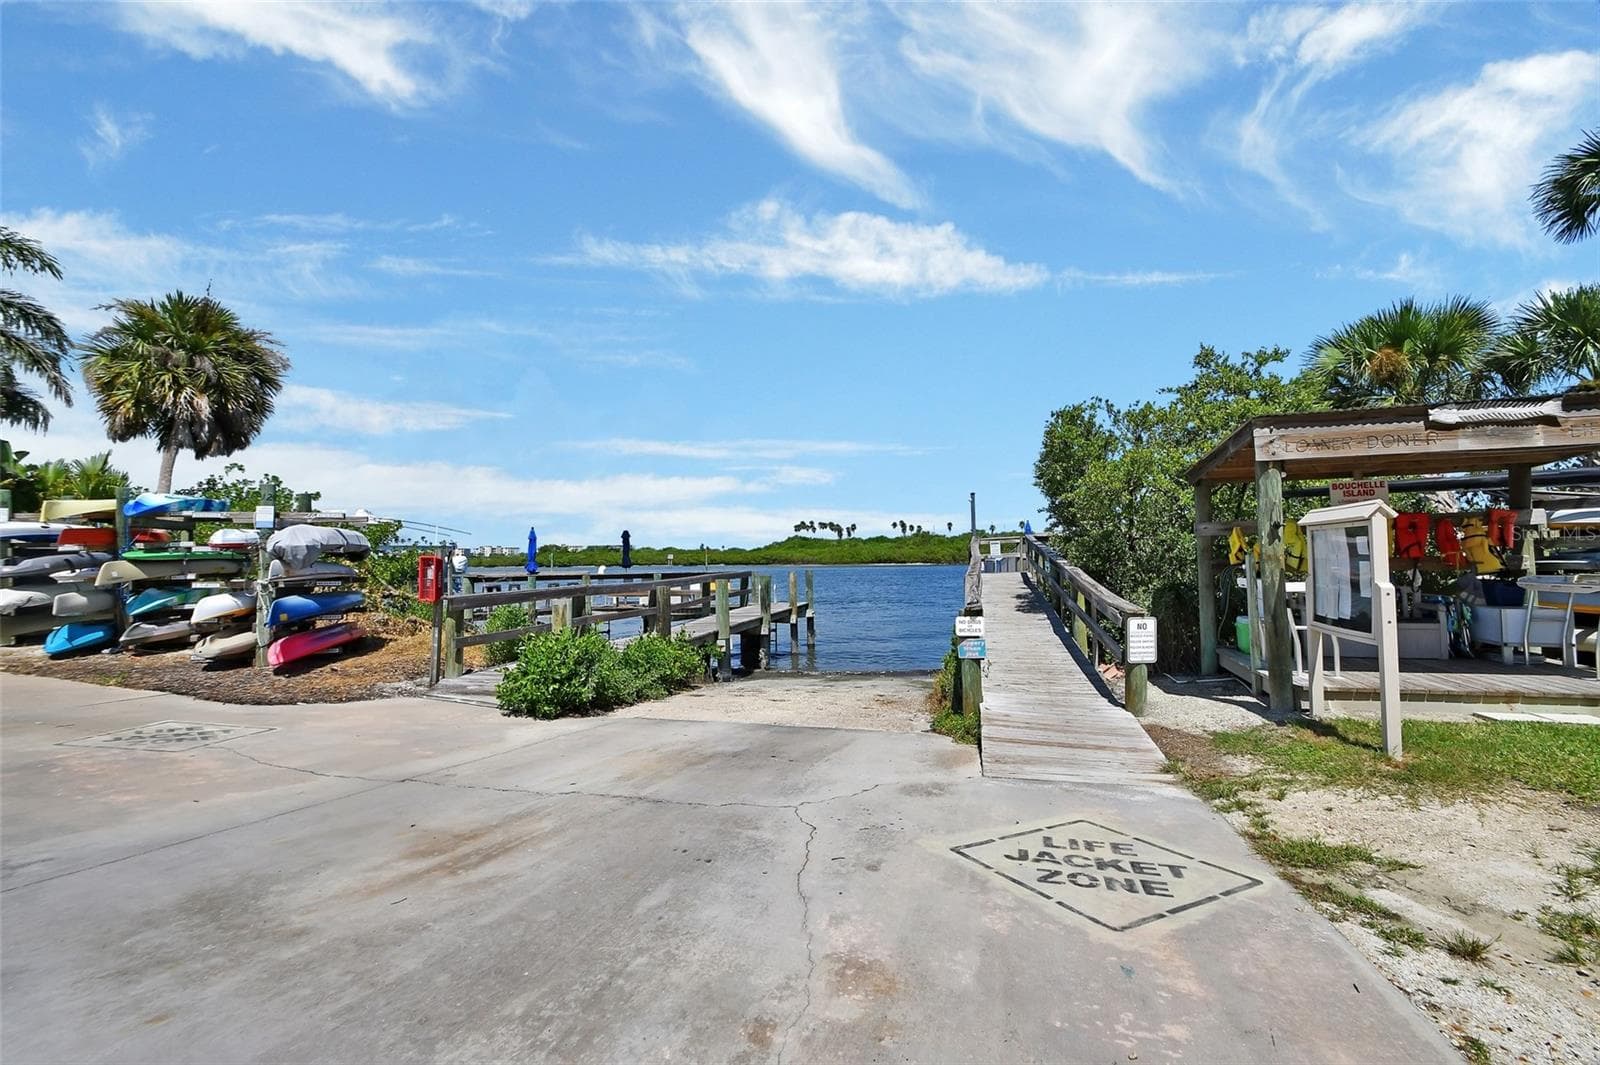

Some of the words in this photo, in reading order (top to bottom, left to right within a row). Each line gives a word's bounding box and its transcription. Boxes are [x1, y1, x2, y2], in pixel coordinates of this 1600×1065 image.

[1366, 432, 1439, 449] DONER
[1331, 480, 1386, 491] BOUCHELLE
[1343, 489, 1376, 498] ISLAND
[1136, 622, 1148, 631] NO
[1042, 835, 1139, 857] LIFE
[1003, 849, 1188, 880] JACKET
[1036, 868, 1175, 898] ZONE
